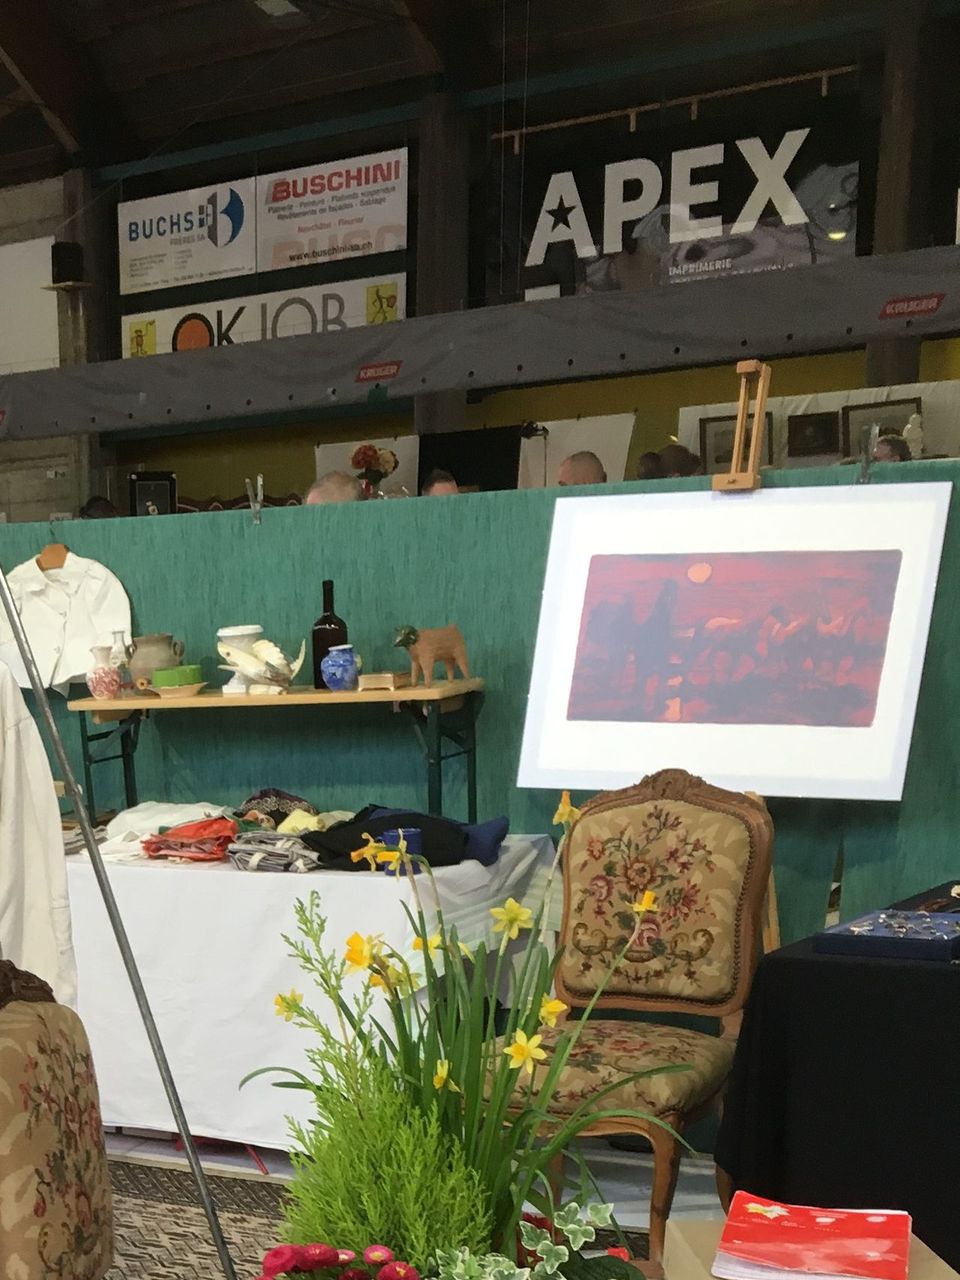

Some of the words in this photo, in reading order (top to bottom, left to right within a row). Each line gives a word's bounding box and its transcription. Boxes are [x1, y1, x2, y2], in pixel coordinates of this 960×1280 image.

[271, 160, 401, 203] BUSCHINI
[525, 127, 810, 268] APEX
[128, 211, 195, 242] BUCHS
[172, 306, 247, 353] OK
